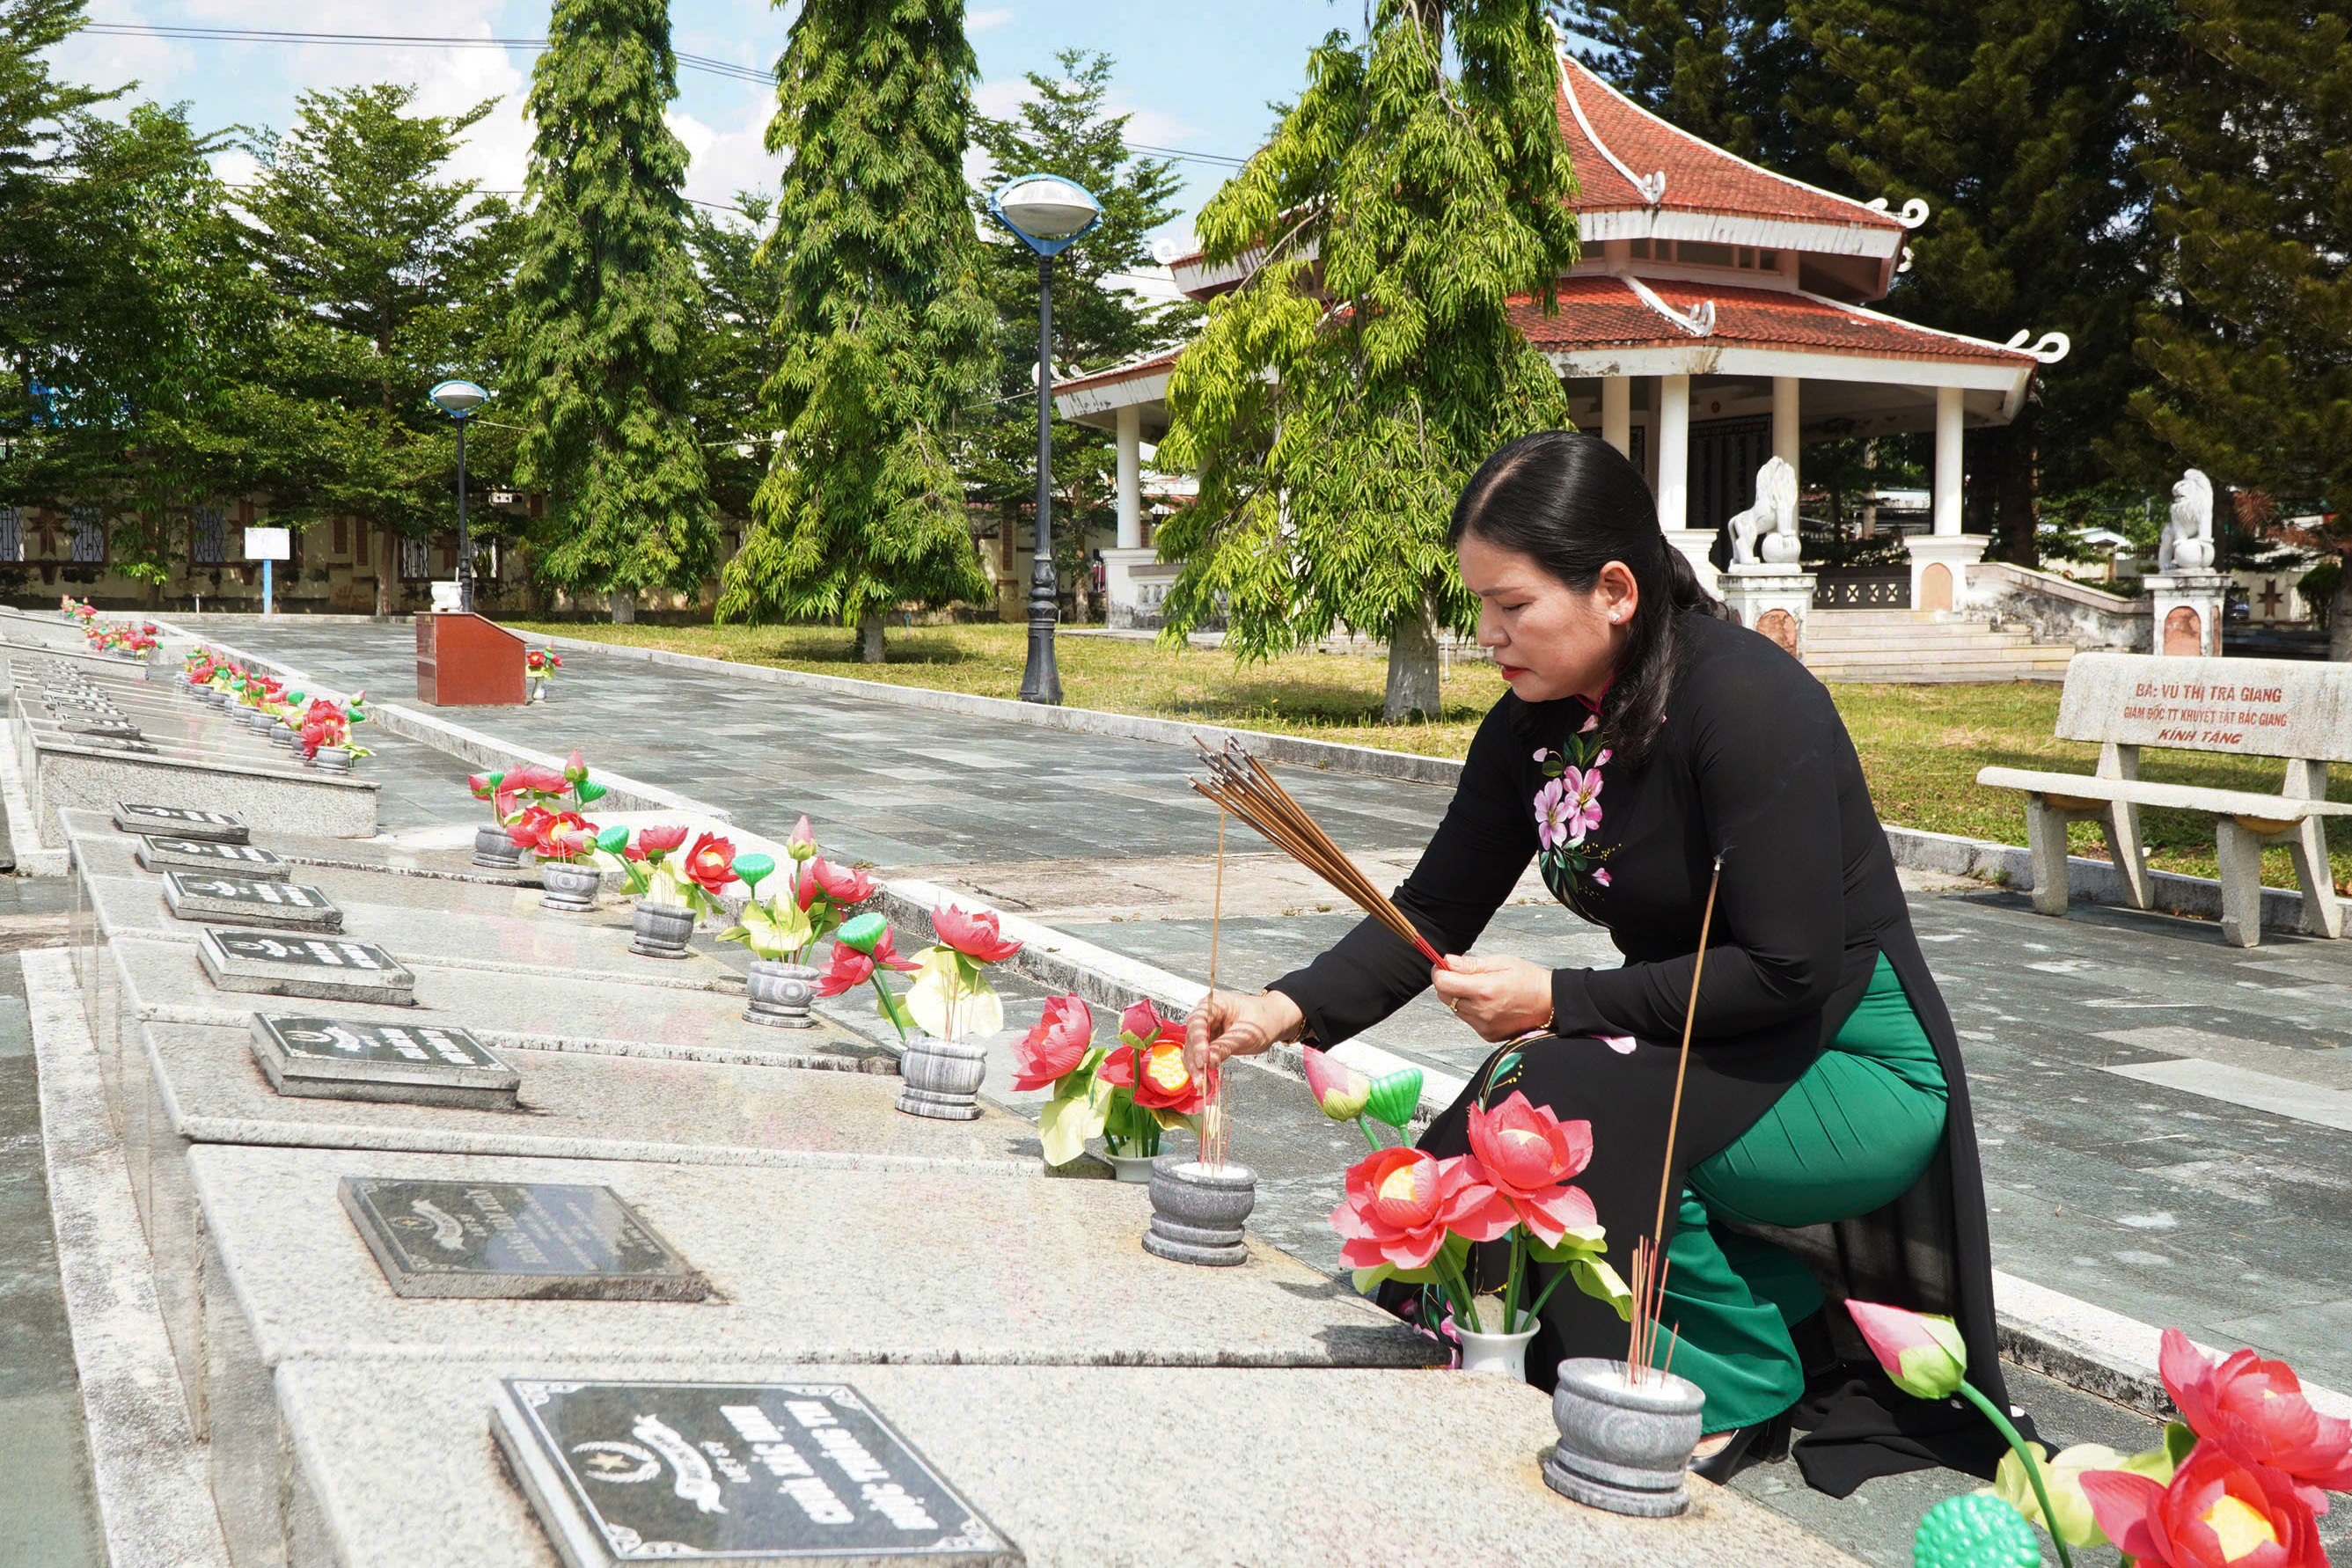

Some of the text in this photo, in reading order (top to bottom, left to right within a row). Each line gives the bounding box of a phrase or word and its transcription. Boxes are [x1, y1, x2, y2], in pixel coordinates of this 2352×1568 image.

[2241, 686, 2282, 703] GIANG
[2168, 708, 2179, 721] TT
[2259, 712, 2288, 727] GIANG
